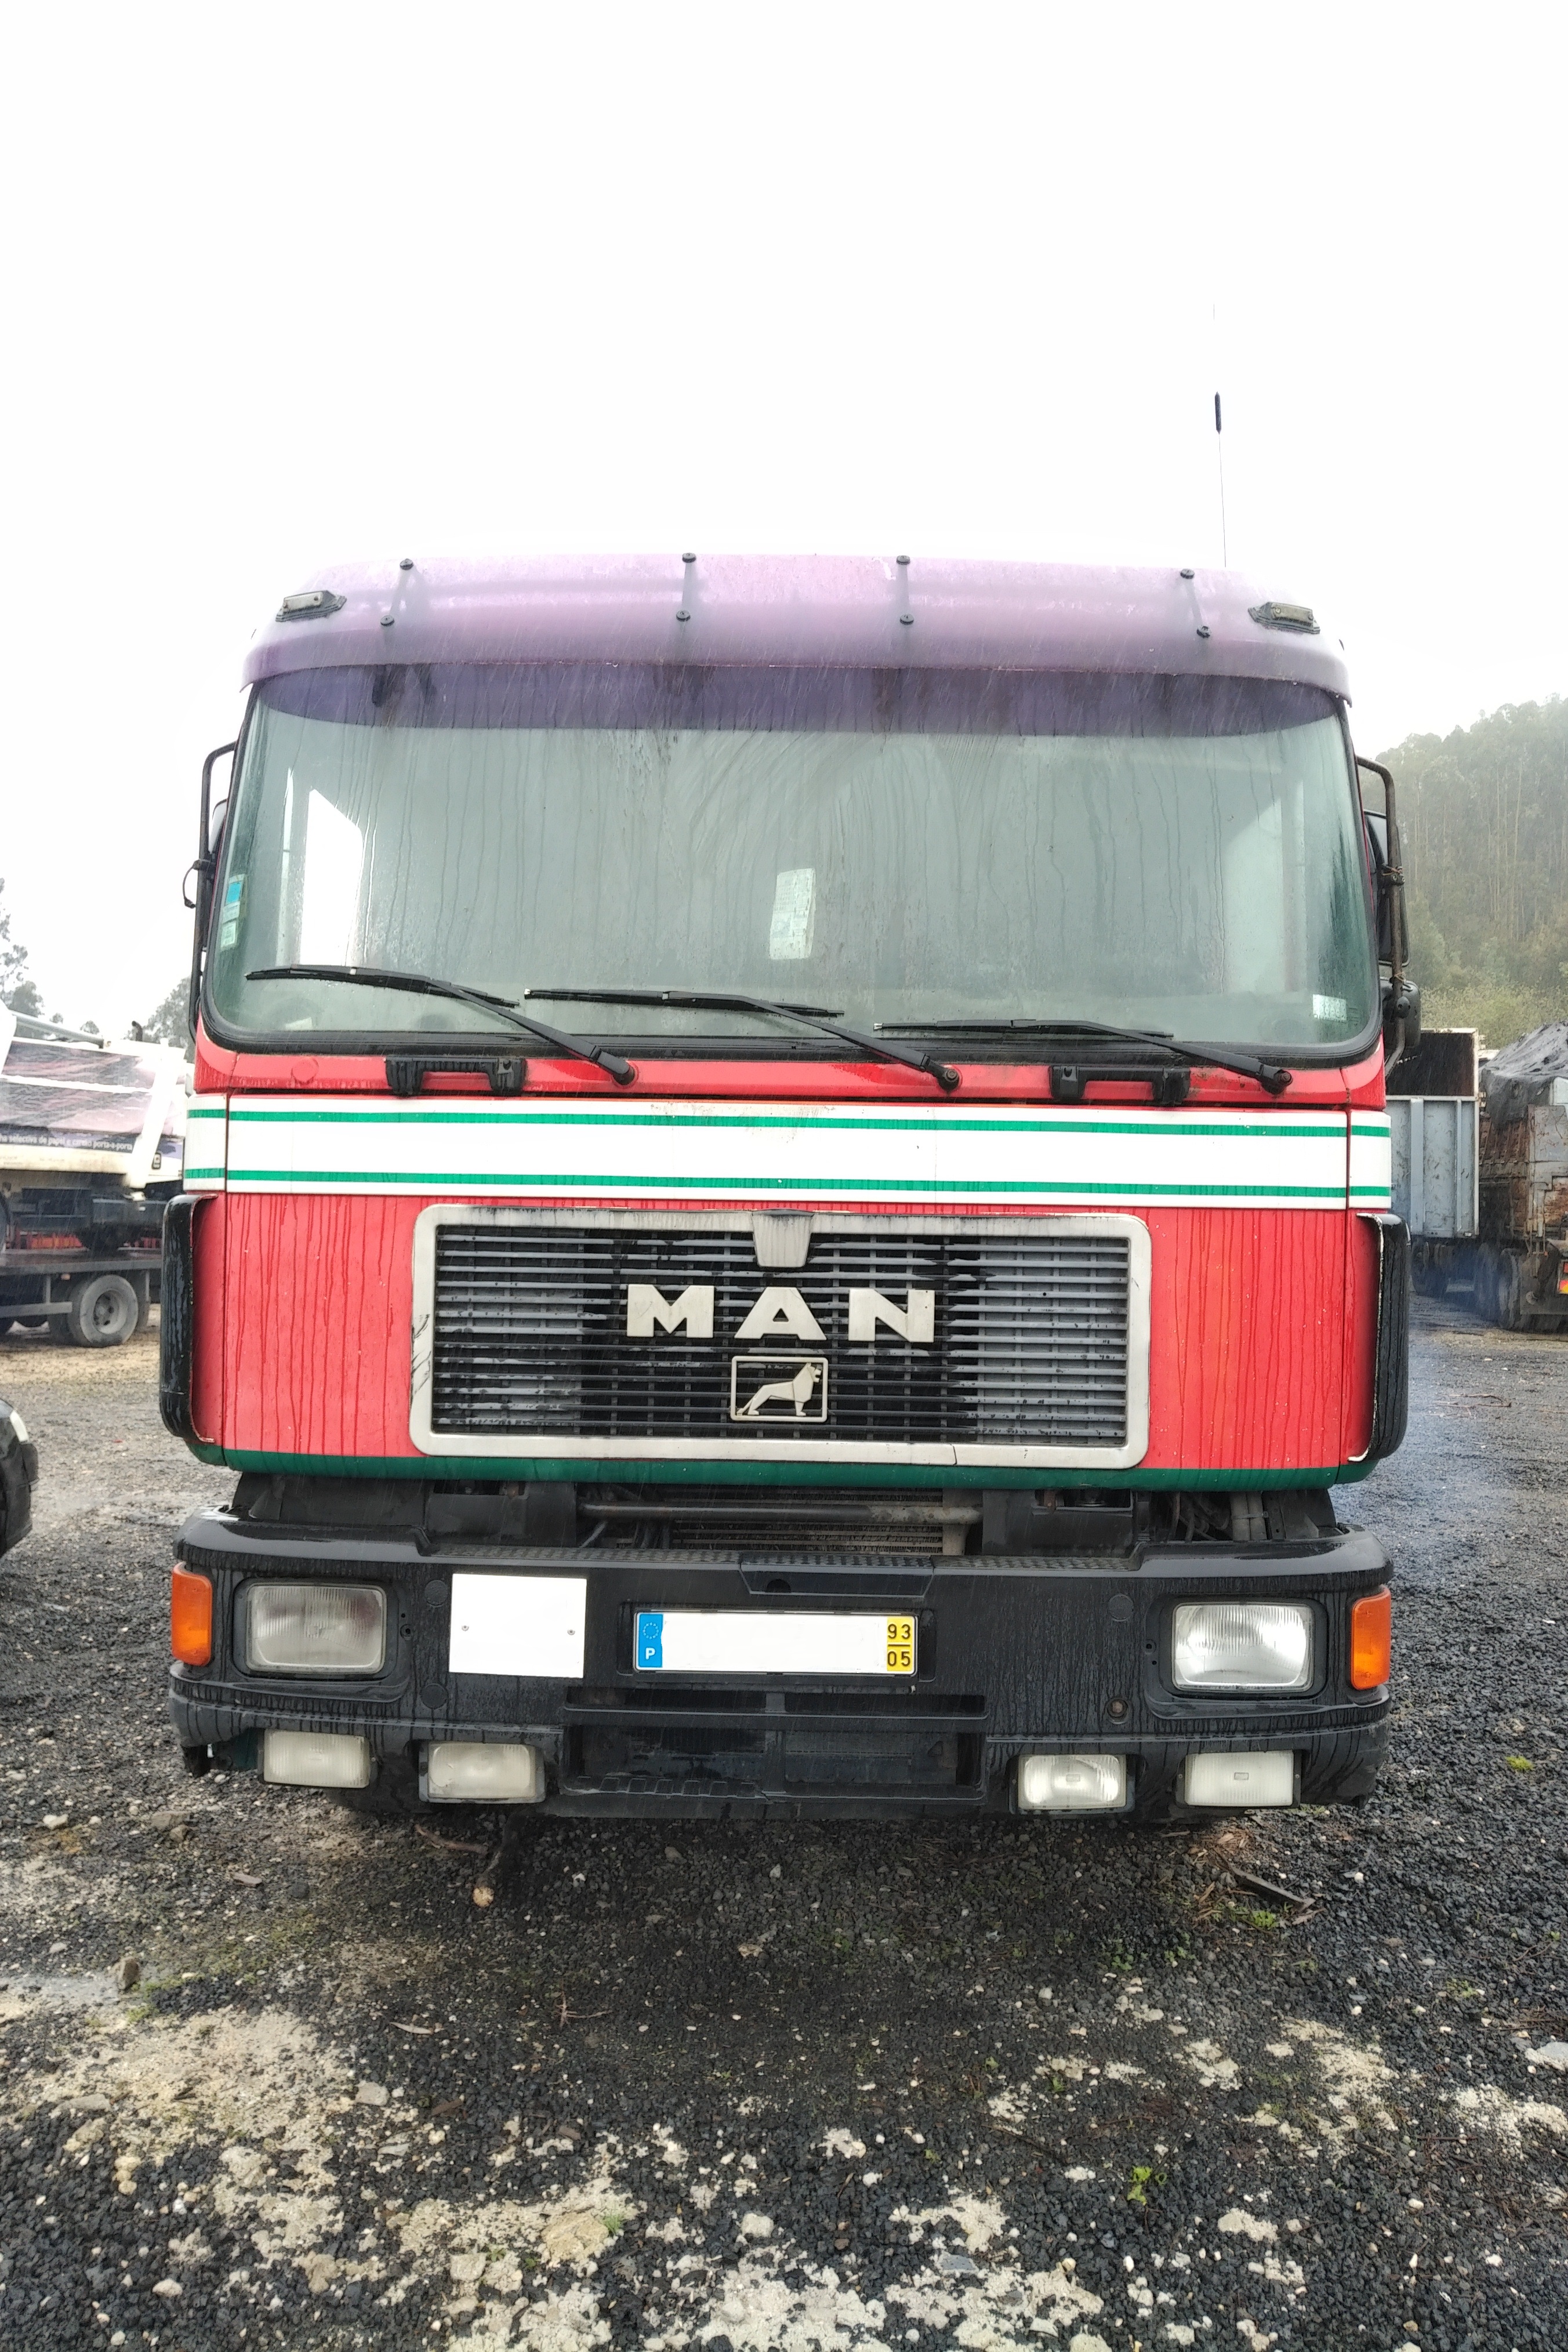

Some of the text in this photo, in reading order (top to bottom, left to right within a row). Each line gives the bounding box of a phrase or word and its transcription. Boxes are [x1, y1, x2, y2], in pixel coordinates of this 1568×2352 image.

[38, 1135, 47, 1144] de
[48, 1137, 65, 1146] papel
[627, 1283, 935, 1342] MAN
[888, 1624, 910, 1639] 93
[645, 1647, 655, 1660] P
[888, 1651, 910, 1666] 05
